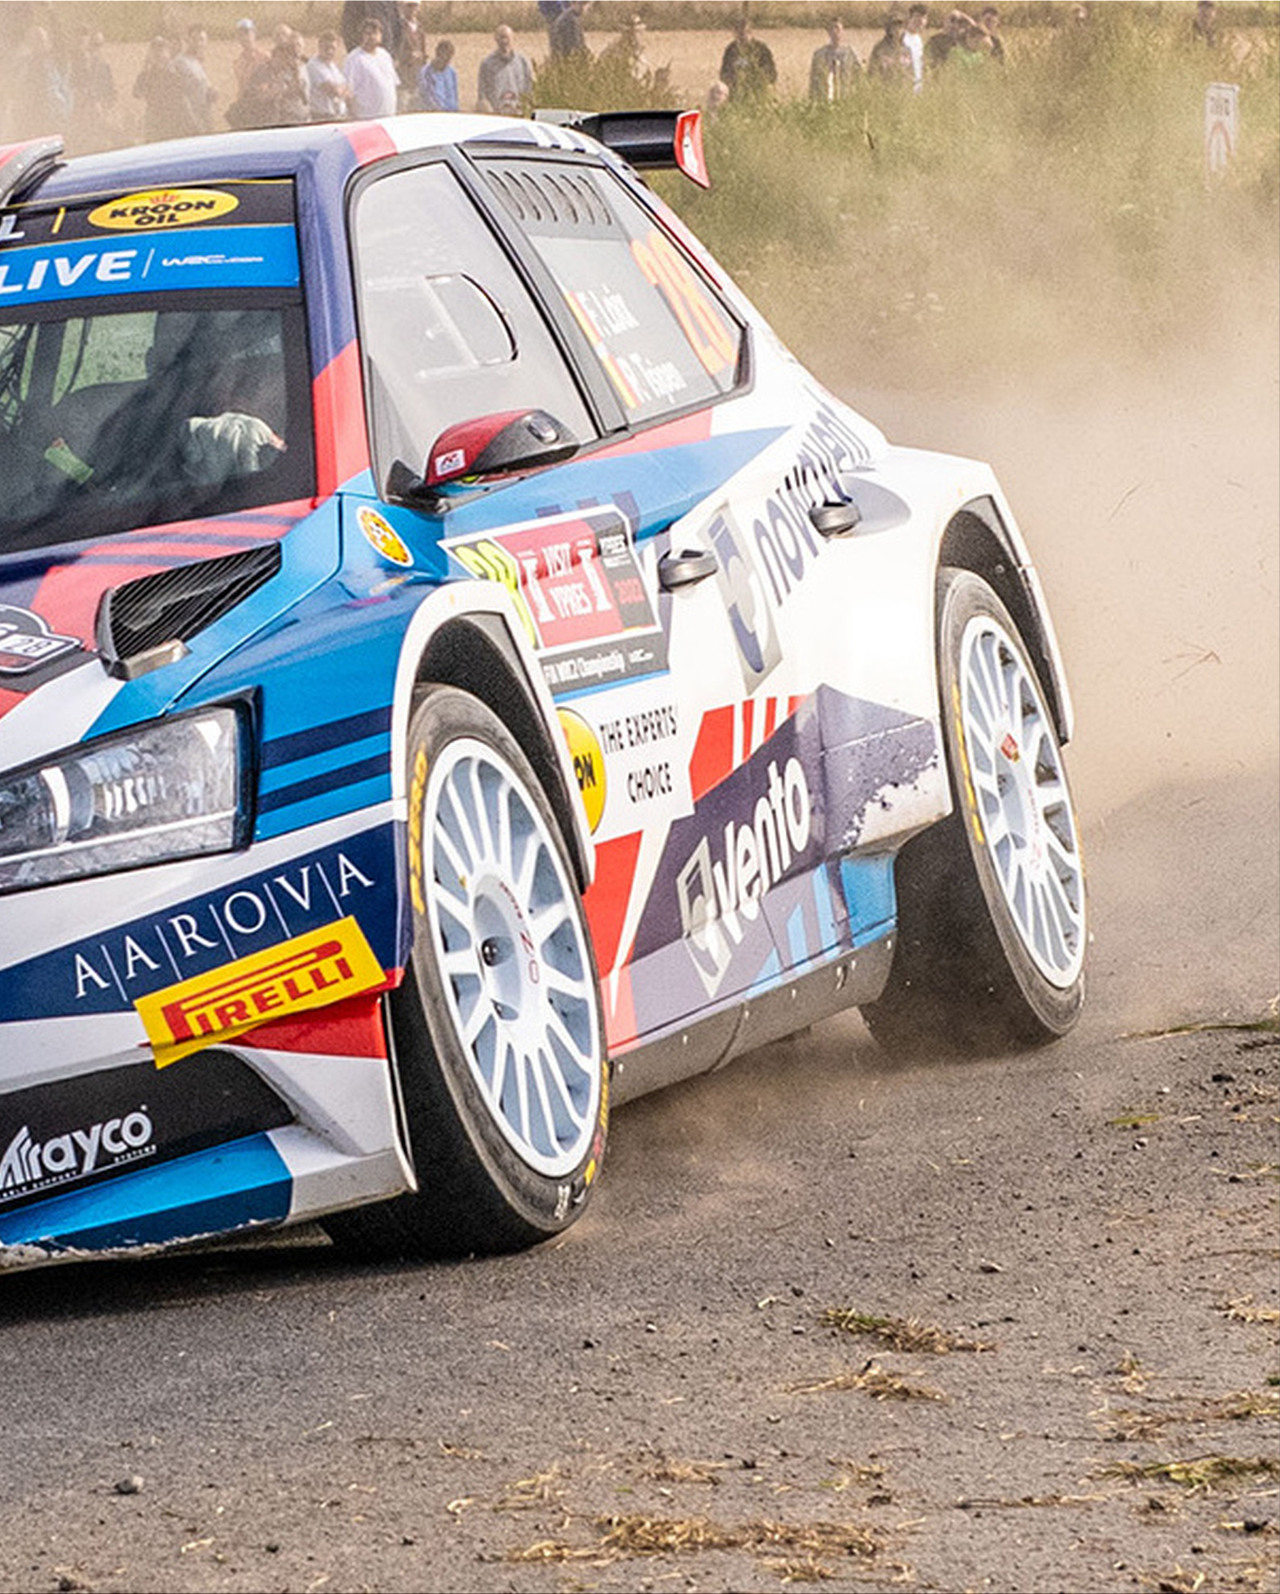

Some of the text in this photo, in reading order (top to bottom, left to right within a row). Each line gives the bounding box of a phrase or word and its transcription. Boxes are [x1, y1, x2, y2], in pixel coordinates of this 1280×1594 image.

[109, 199, 217, 219] KROON
[134, 211, 180, 225] OIL
[600, 720, 624, 754] THE
[627, 762, 672, 803] CHOICE
[713, 756, 811, 945] vento
[74, 853, 376, 1000] AAROVA
[161, 940, 354, 1043] PIRELLI
